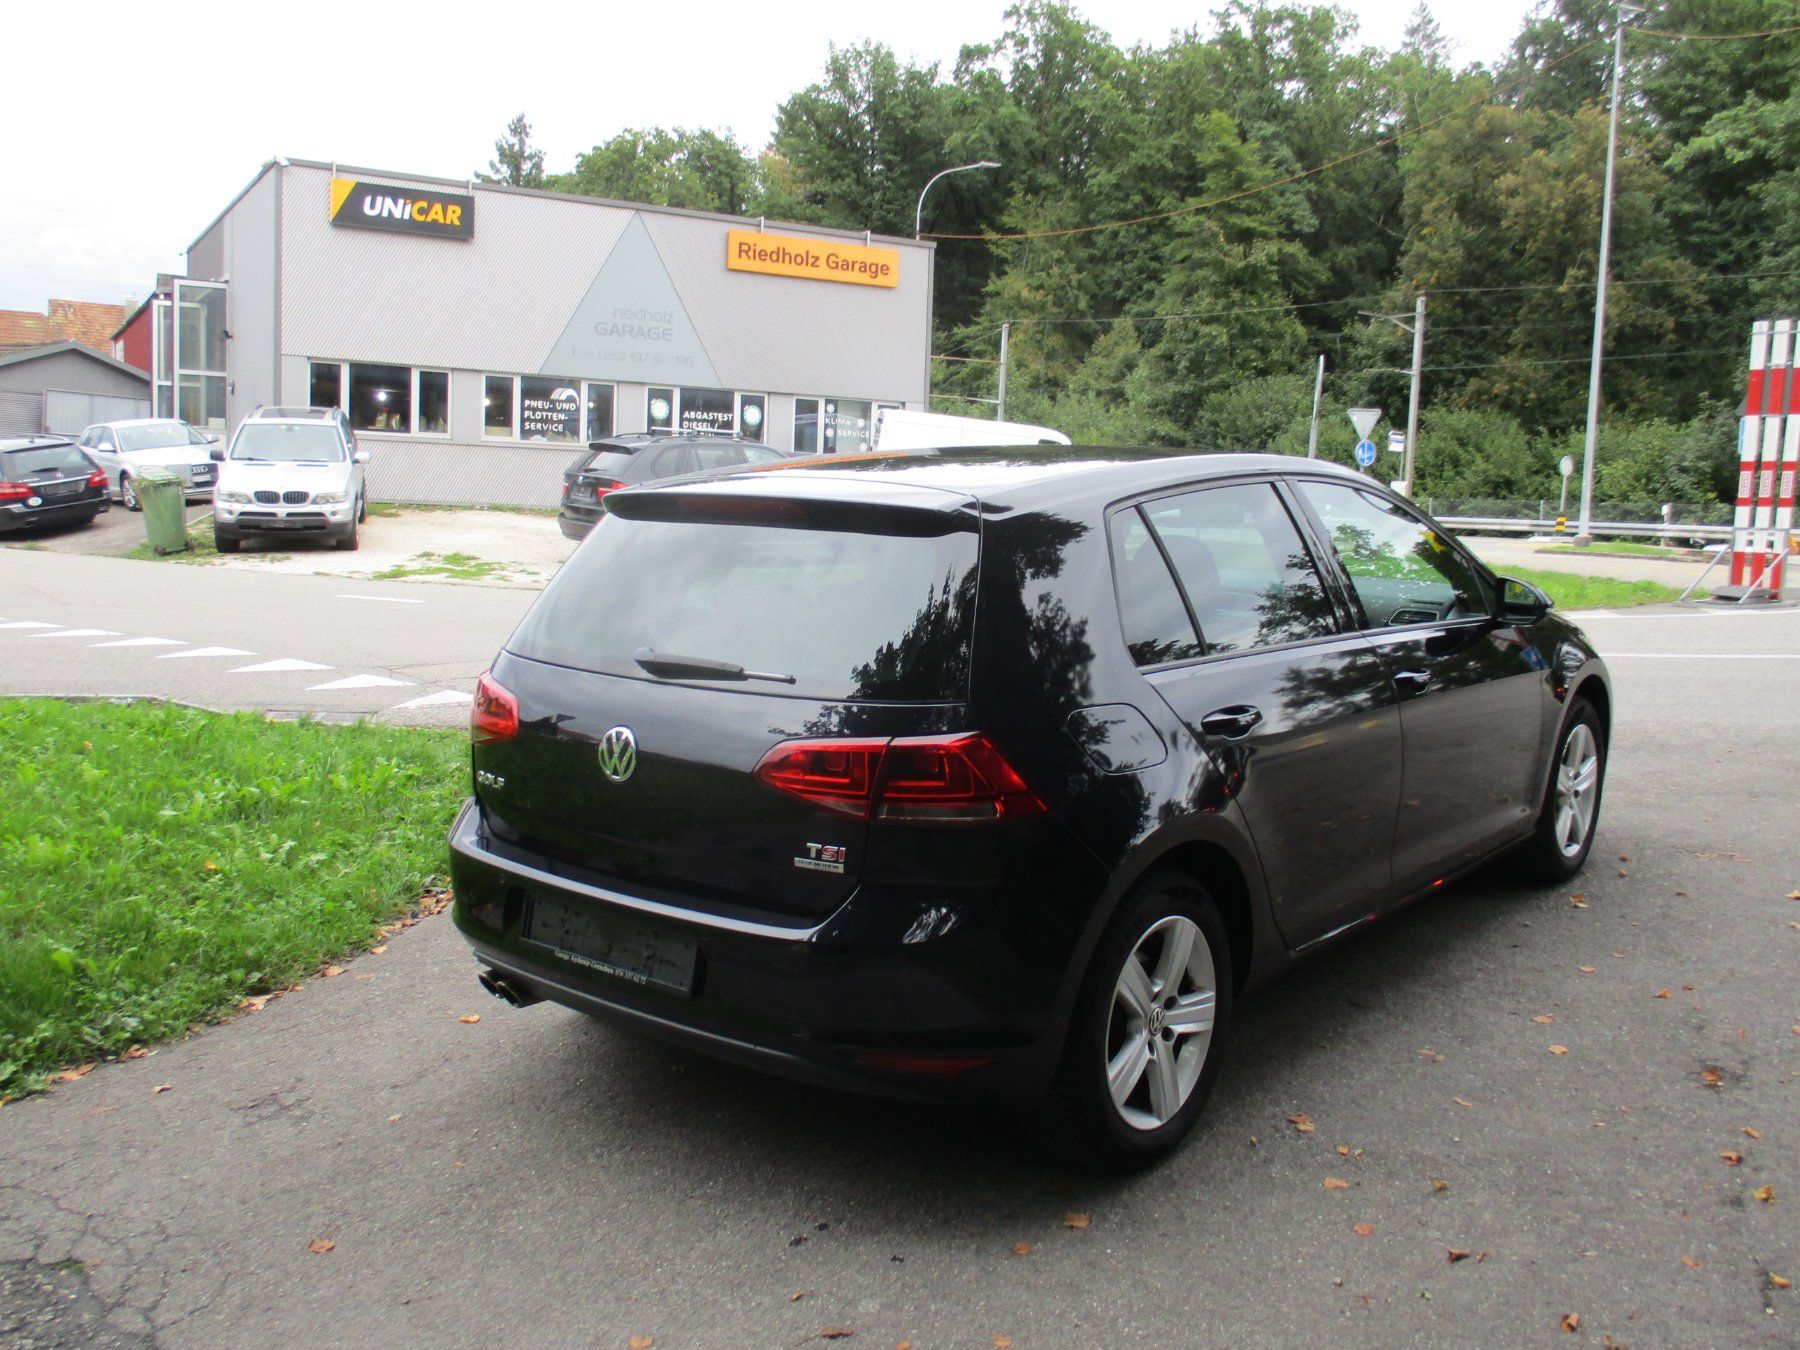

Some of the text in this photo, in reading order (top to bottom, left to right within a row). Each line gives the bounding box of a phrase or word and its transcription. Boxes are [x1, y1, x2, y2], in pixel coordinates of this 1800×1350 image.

[737, 241, 891, 280] Riedholz Garage
[593, 320, 674, 342] GARAGE
[524, 399, 577, 411] PNEU- UND
[524, 410, 569, 421] FLOTTEN-
[683, 410, 734, 422] ABGASTEST
[524, 421, 564, 432] SERVICE
[838, 429, 870, 439] SERVICE
[806, 842, 847, 863] TSI
